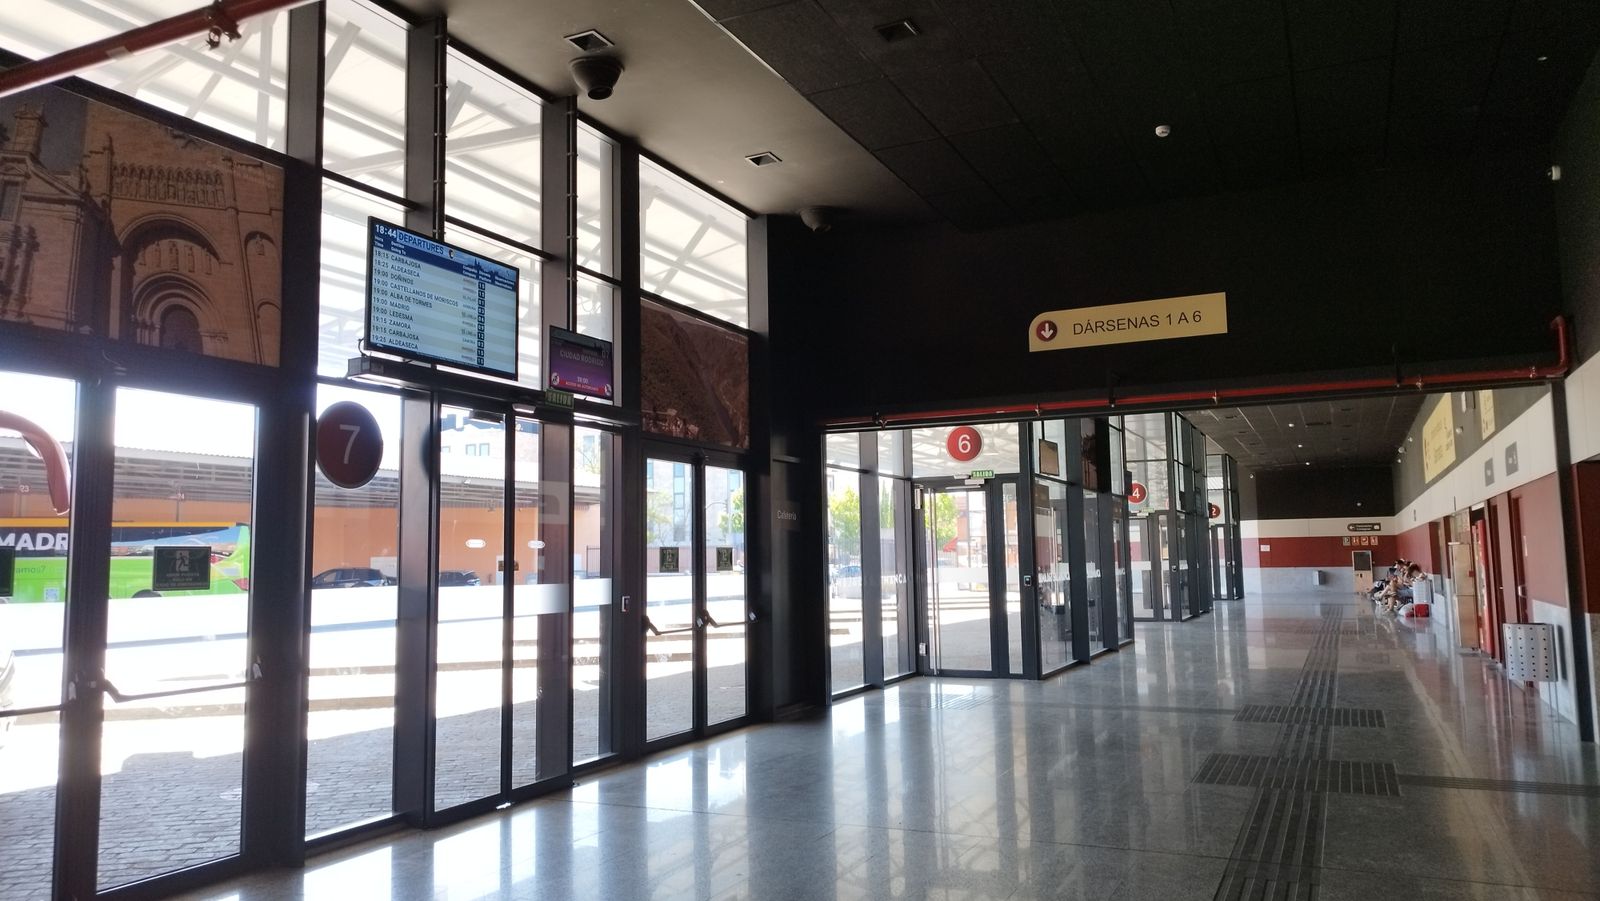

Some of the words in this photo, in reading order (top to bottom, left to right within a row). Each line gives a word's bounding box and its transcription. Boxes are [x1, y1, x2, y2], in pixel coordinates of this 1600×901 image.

[375, 224, 397, 238] 18:44
[398, 232, 444, 255] DEPARTURES
[390, 254, 421, 270] CARBAJOSA
[374, 268, 389, 277] 19:00
[390, 264, 420, 278] ALDEASECA
[373, 278, 388, 287] 19:00
[390, 283, 426, 298] CASTELLANOS
[434, 295, 459, 307] MORISCOS
[373, 287, 388, 296] 19:00
[389, 292, 404, 301] ALBA
[404, 295, 413, 303] DE
[412, 297, 433, 309] TORMES
[373, 296, 388, 305] 19:00
[389, 301, 410, 312] MADRID
[372, 306, 388, 315] 19:00
[389, 310, 414, 321] LEDESMA
[372, 315, 387, 324] 19:15
[388, 319, 411, 330] ZAMORA
[1073, 314, 1160, 336] DÁRSENAS
[1166, 313, 1172, 326] 1
[1177, 311, 1189, 324] A
[1193, 310, 1202, 323] 6
[372, 324, 387, 334] 19:15
[388, 329, 420, 341] CARBAJOSA
[372, 334, 387, 343] 19:25
[388, 338, 419, 350] ALDEASECA
[560, 350, 580, 361] CIUDAD
[339, 424, 361, 465] 7
[958, 434, 972, 453] 6
[1132, 488, 1140, 499] 4
